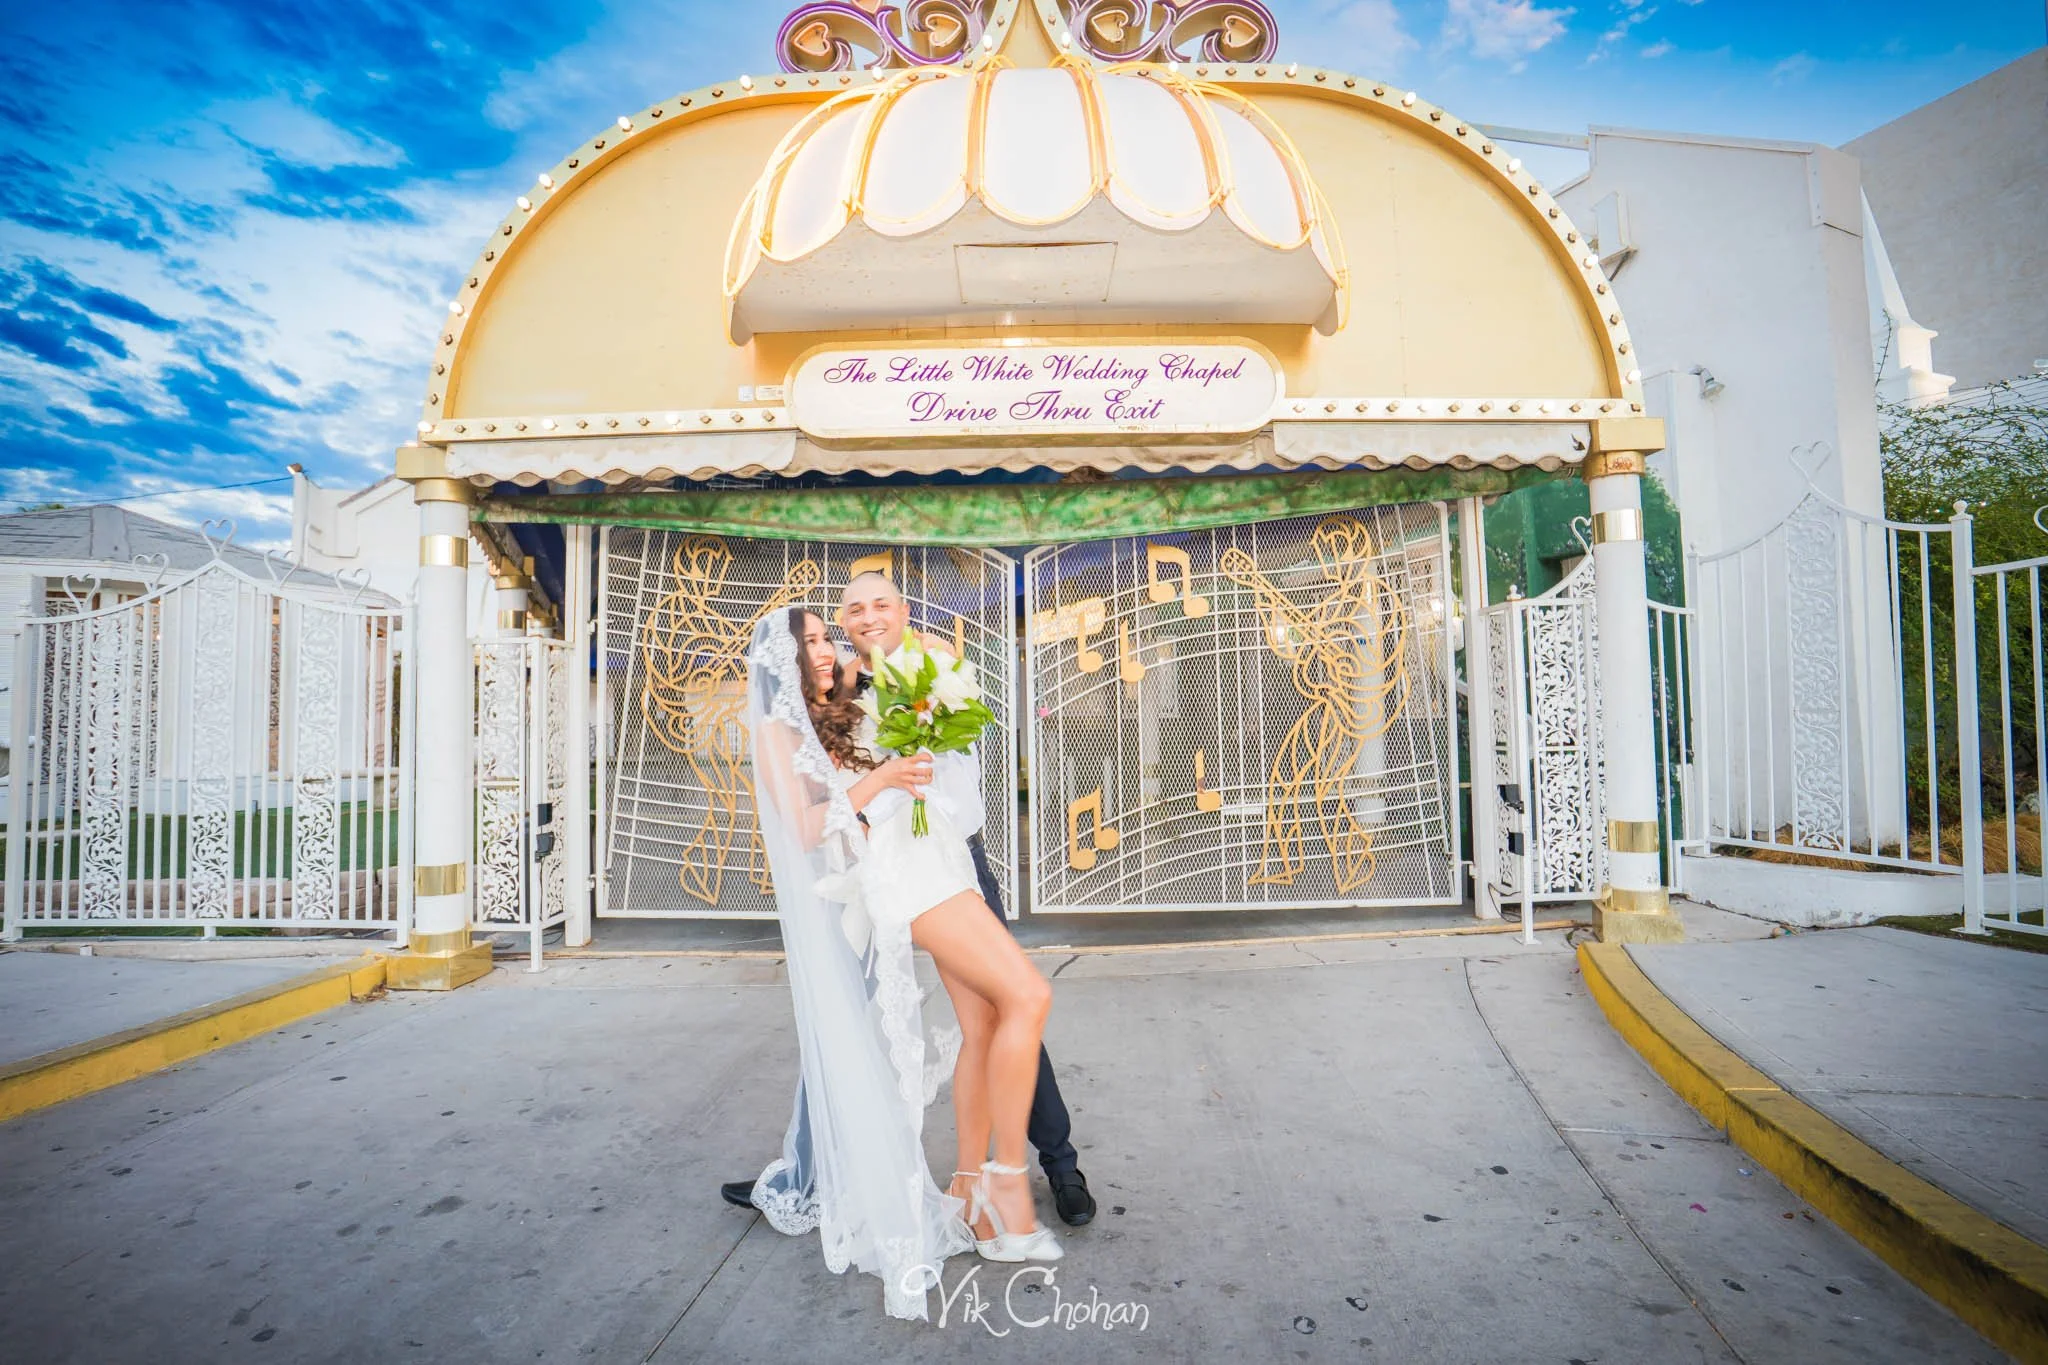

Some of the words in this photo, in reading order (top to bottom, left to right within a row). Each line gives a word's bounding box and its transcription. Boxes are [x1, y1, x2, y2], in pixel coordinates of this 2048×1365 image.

[824, 357, 877, 385] The
[886, 356, 955, 384] Little
[963, 355, 1034, 382] White
[1043, 353, 1149, 387] Wedding
[1158, 353, 1246, 388] Chapel
[907, 390, 998, 423] Drive
[1009, 389, 1093, 422] Thru
[1104, 388, 1166, 422] Exit
